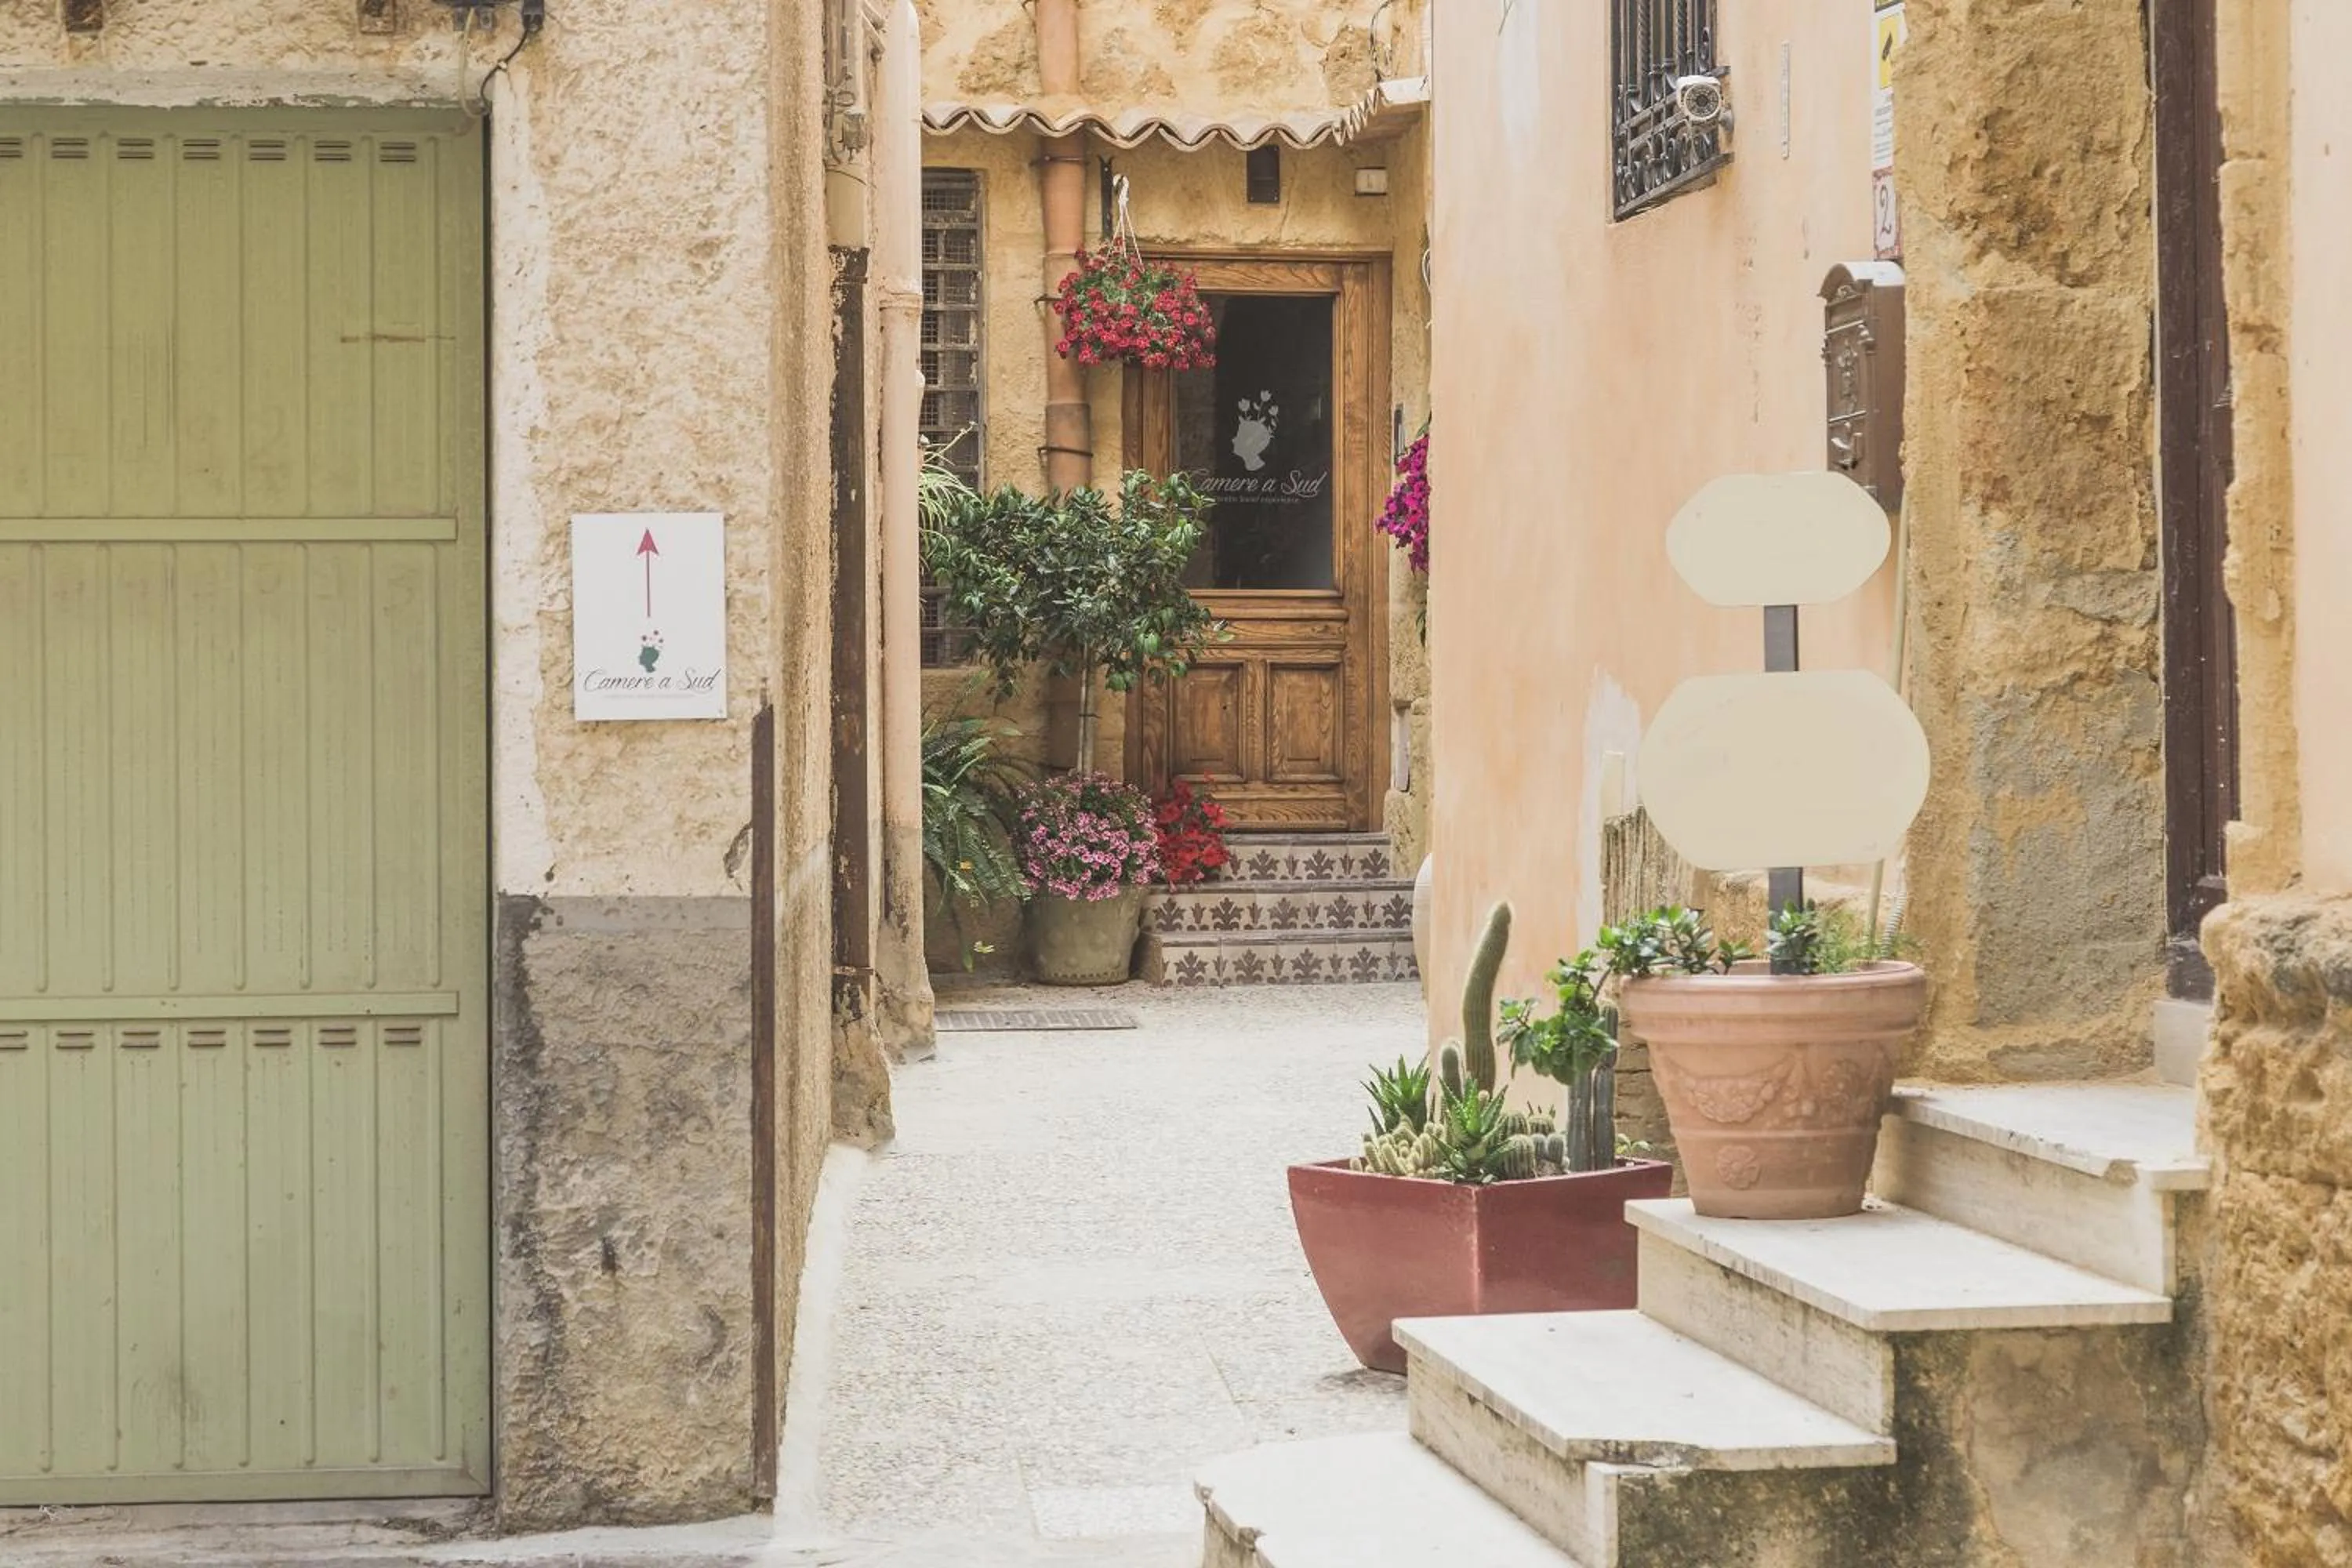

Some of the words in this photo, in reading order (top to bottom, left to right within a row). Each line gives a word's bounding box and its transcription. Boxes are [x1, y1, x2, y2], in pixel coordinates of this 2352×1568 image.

[1879, 184, 1892, 234] 2
[1261, 477, 1277, 492] a
[1280, 470, 1327, 498] Sud
[583, 668, 653, 691] Camere
[658, 677, 672, 689] a
[677, 668, 721, 695] Sud
